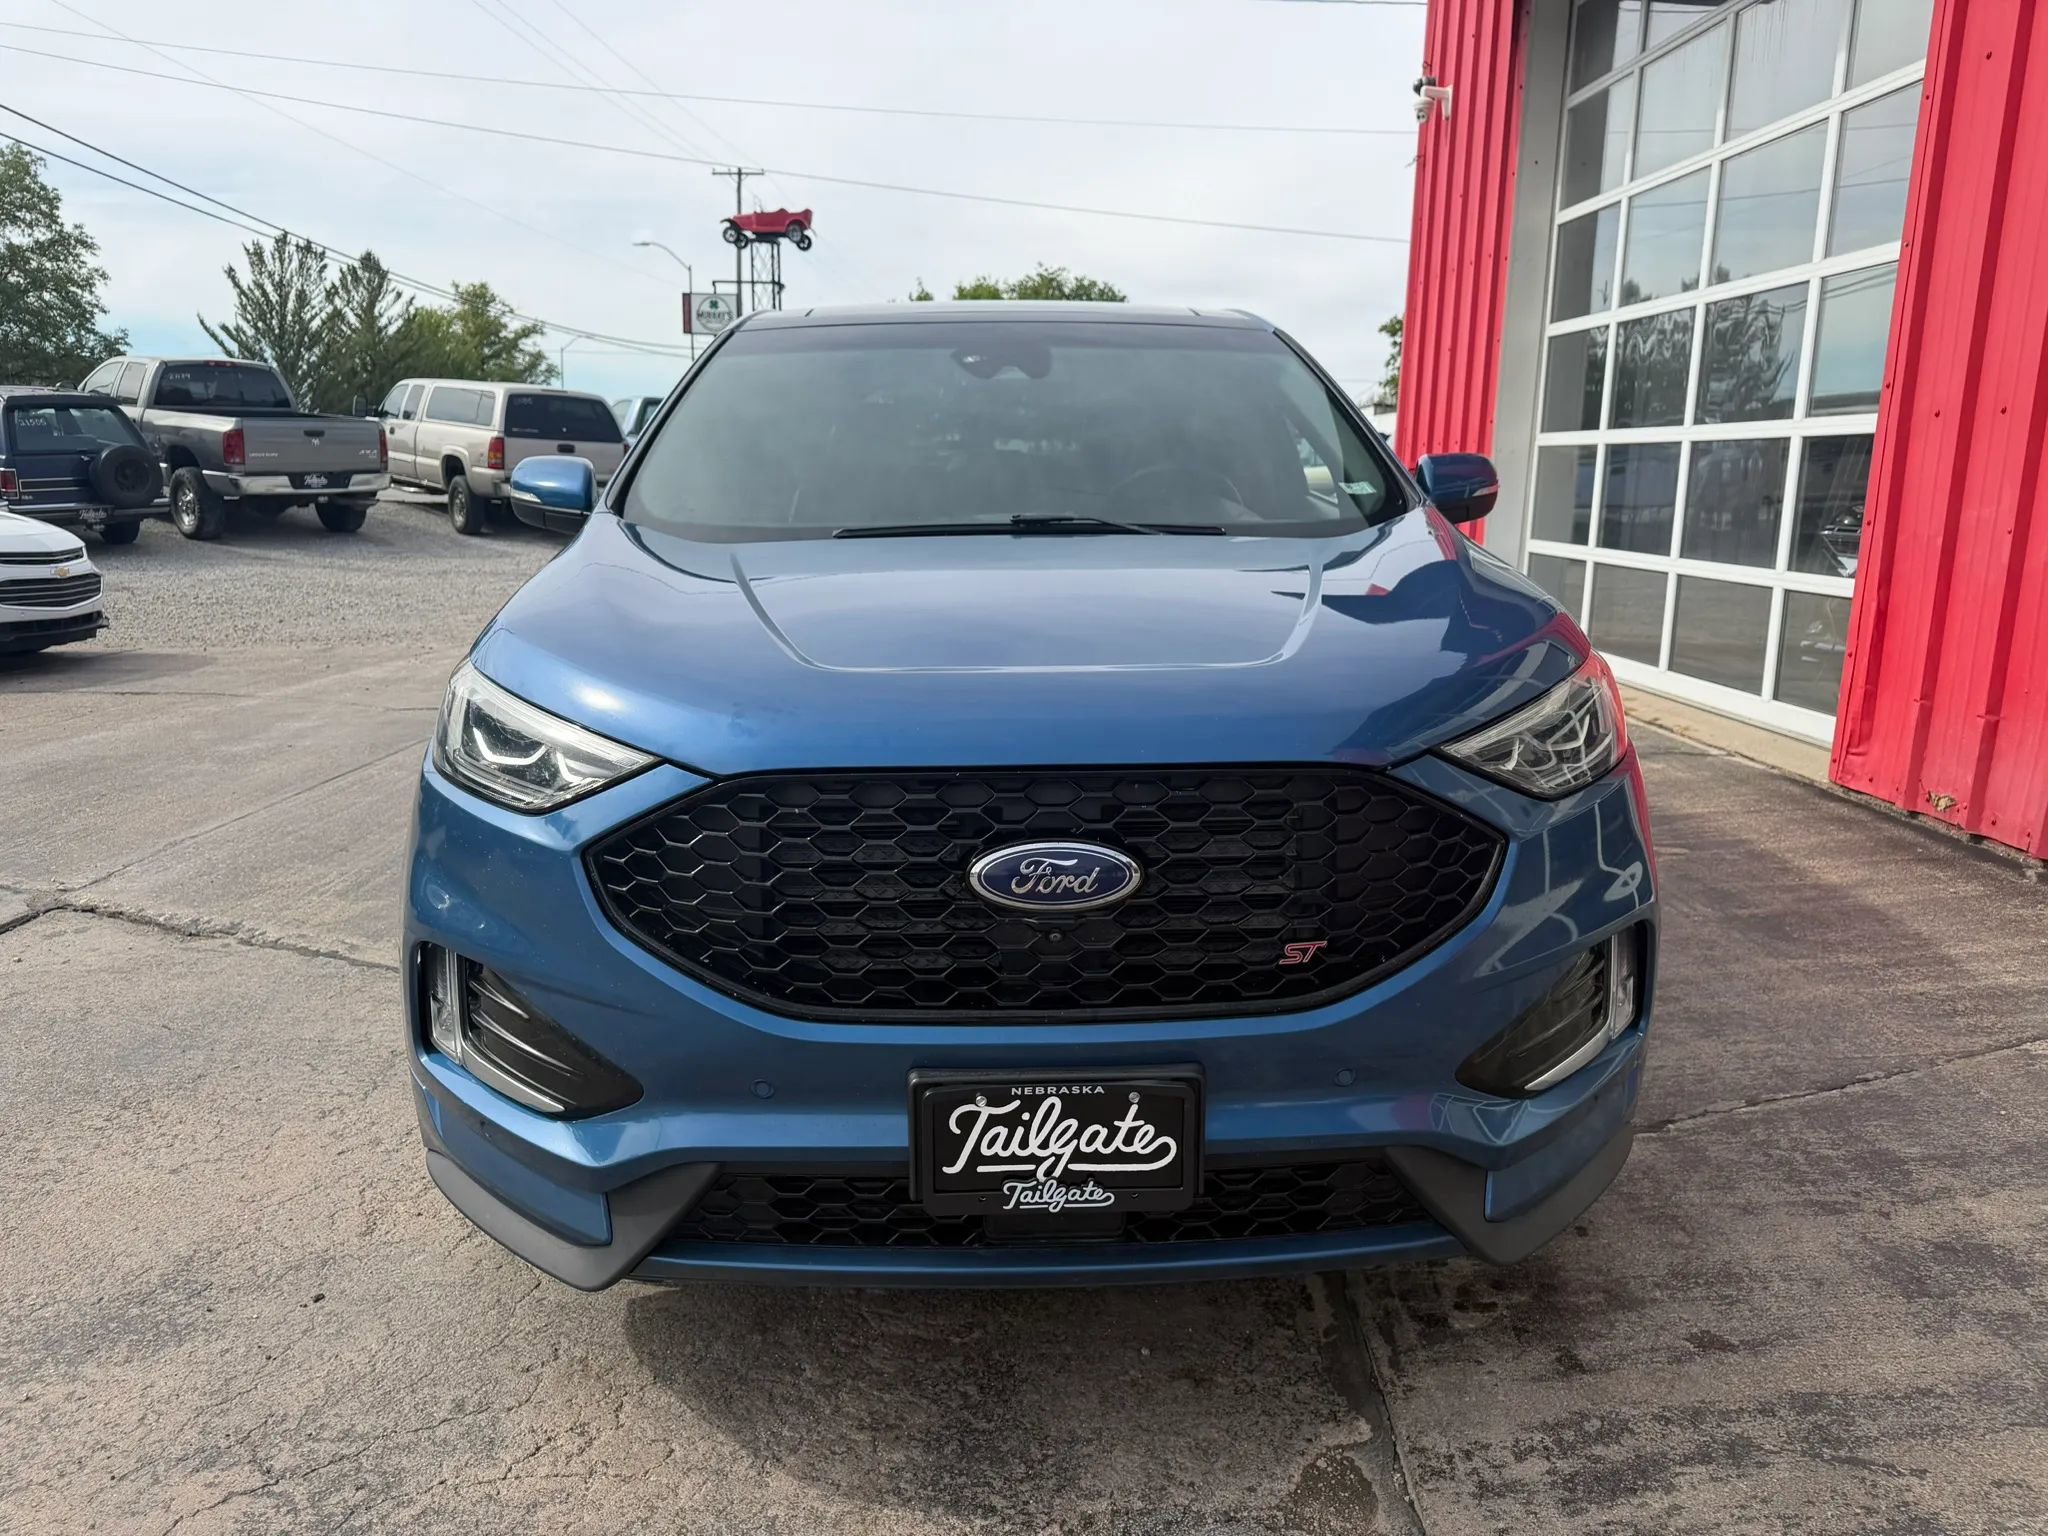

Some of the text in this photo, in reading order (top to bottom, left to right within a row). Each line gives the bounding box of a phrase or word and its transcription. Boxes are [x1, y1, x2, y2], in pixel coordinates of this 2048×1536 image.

[1011, 857, 1100, 894] Ford
[1279, 941, 1327, 965] ST
[1011, 1086, 1105, 1096] NEBRASKA
[942, 1096, 1177, 1183] Tailgate
[1003, 1178, 1114, 1213] Tailgate
